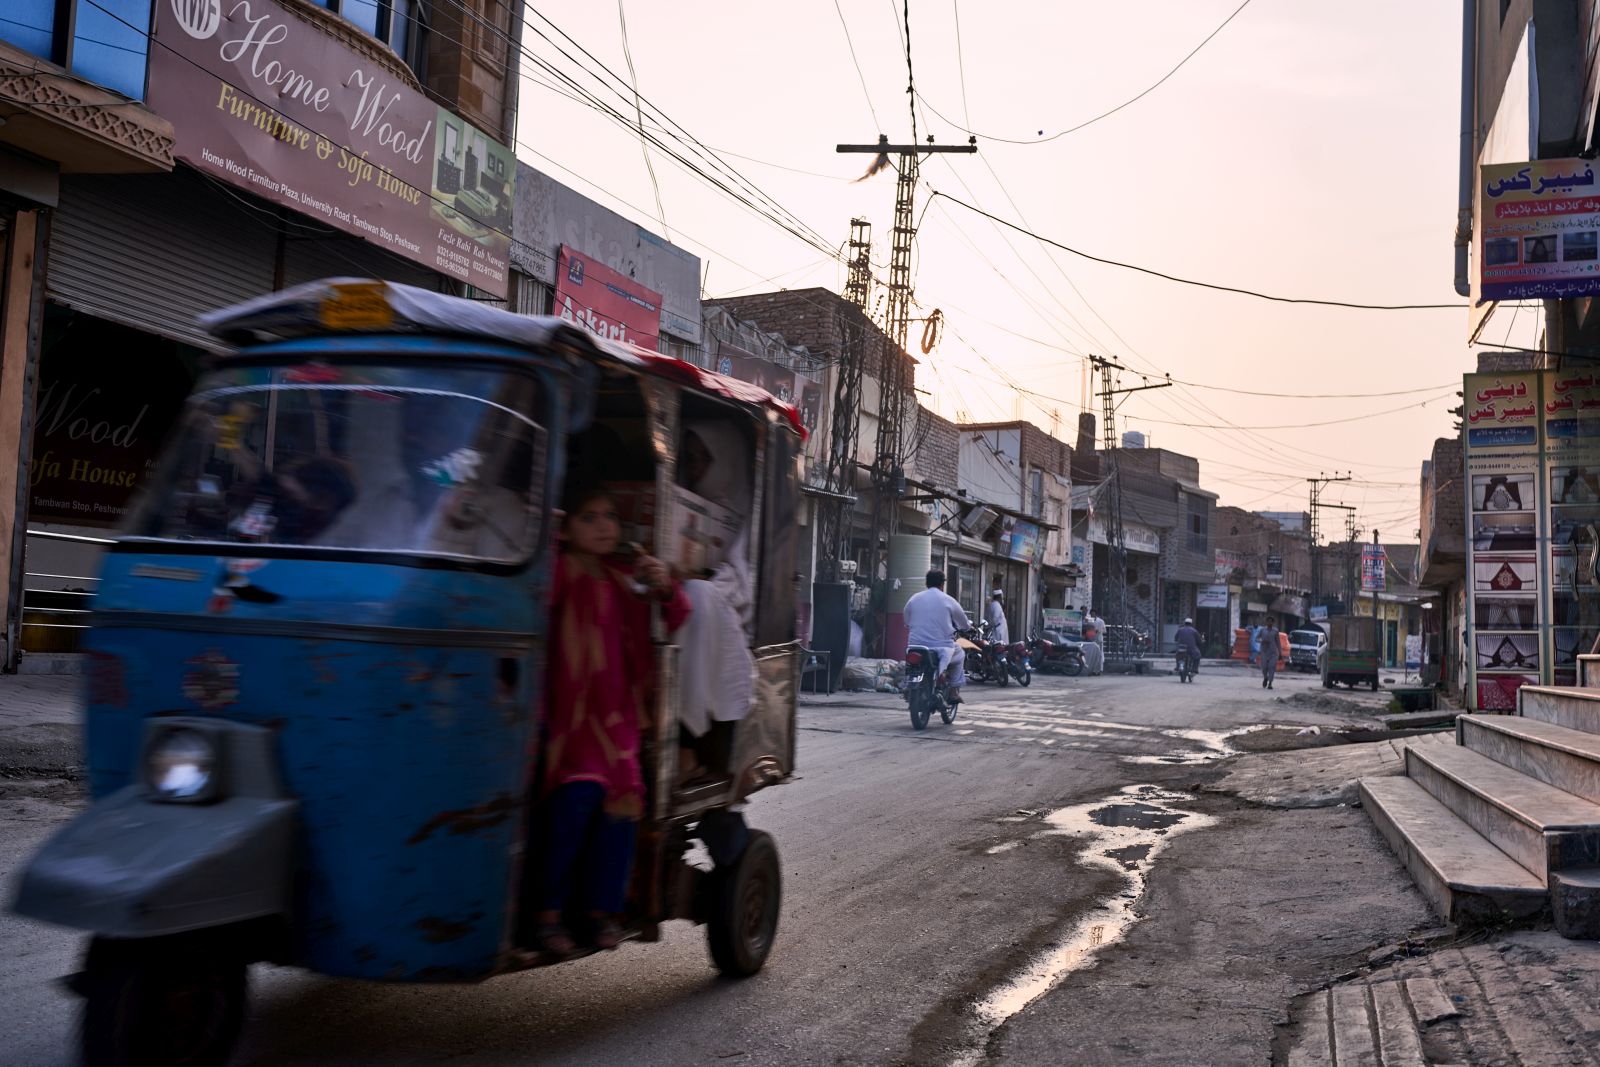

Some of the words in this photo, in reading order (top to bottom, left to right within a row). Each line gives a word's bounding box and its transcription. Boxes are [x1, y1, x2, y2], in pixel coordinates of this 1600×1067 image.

[220, 0, 330, 112] Home
[347, 69, 432, 165] Wood
[216, 80, 310, 150] Furniture
[315, 132, 334, 160] &
[337, 145, 373, 187] Sofa
[376, 163, 421, 206] House
[201, 147, 225, 167] Home
[225, 158, 247, 177] Wood
[247, 168, 280, 192] Furniture
[280, 183, 300, 203] Plaza,
[301, 192, 333, 217] University
[333, 206, 351, 224] Road,
[352, 214, 379, 235] Tambwan
[379, 227, 394, 243] Stop,
[560, 296, 626, 342] Askari
[36, 381, 149, 448] Wood
[34, 496, 71, 509] Tambwan
[72, 500, 92, 514] Stop,
[68, 458, 136, 488] House
